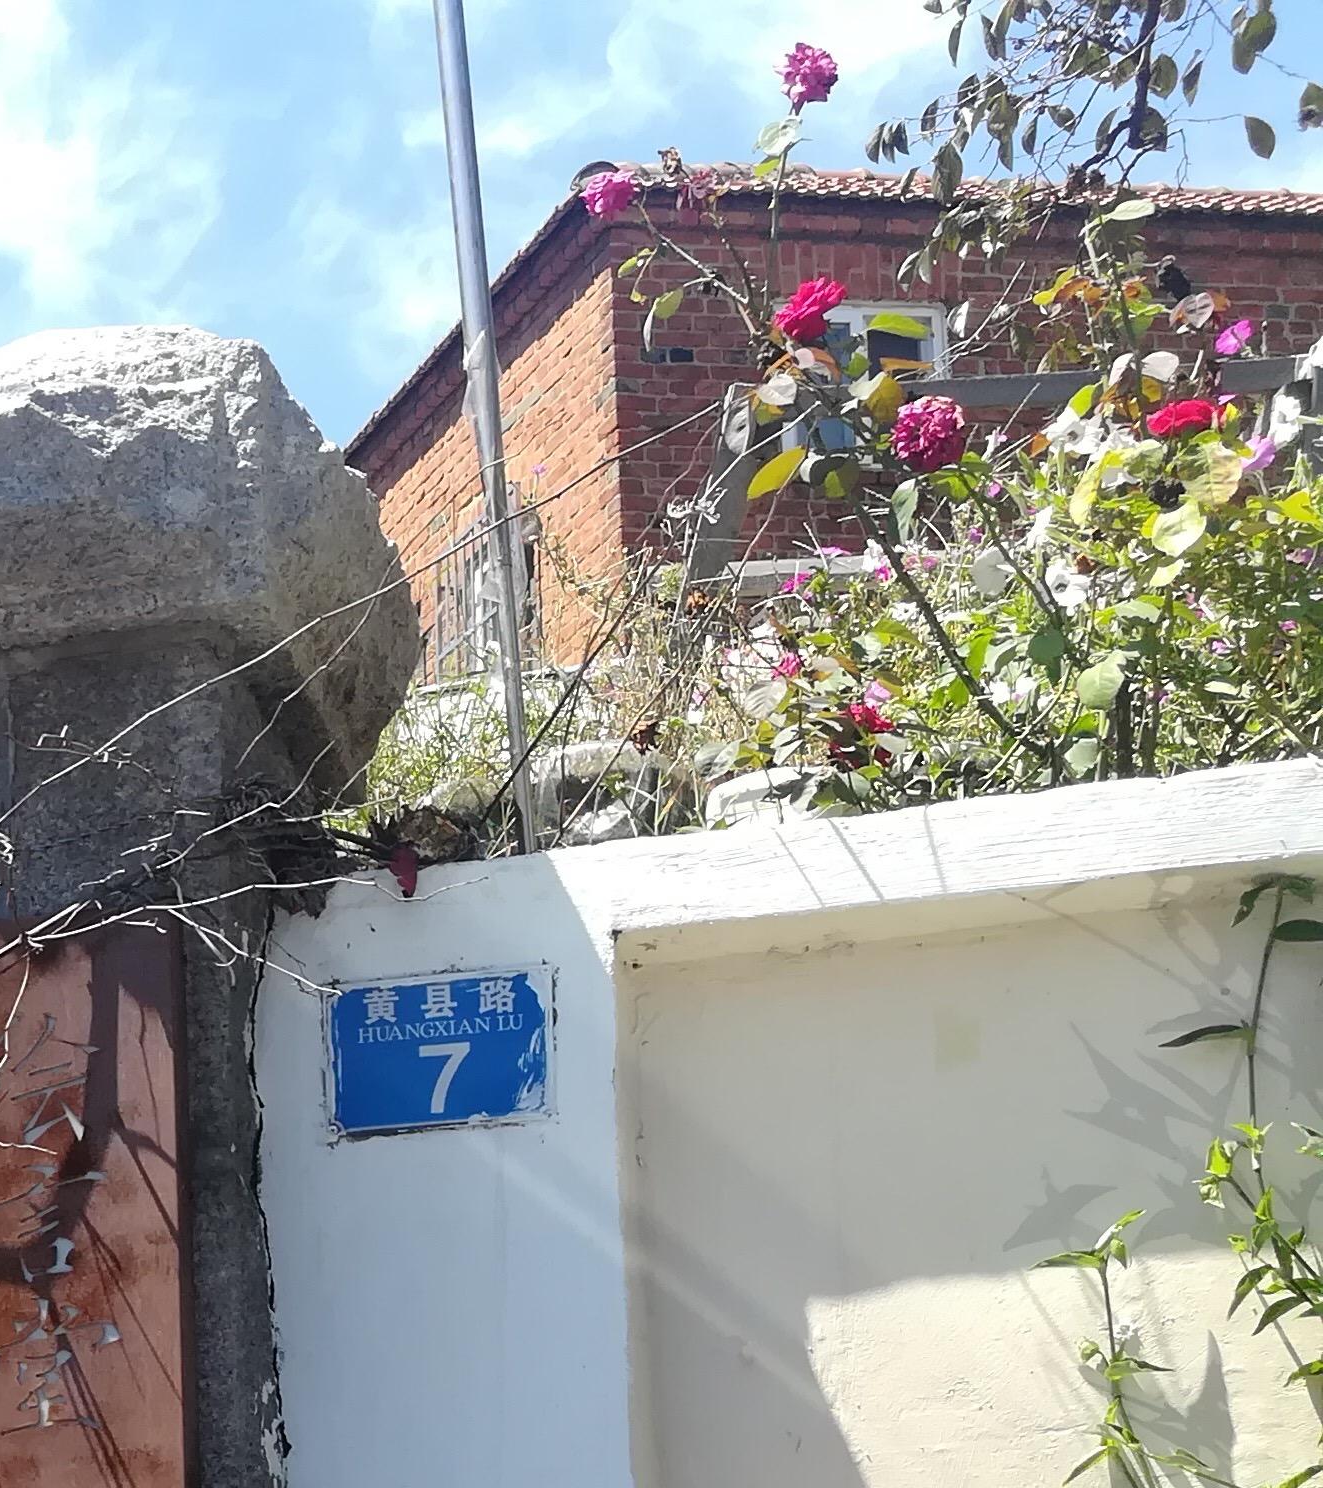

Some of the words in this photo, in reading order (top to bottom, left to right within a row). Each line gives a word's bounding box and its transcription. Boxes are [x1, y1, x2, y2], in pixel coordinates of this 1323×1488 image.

[363, 979, 515, 1024] 黄县路
[357, 1016, 491, 1044] HUANGXIAN
[497, 1013, 524, 1032] LU
[418, 1041, 471, 1114] 7
